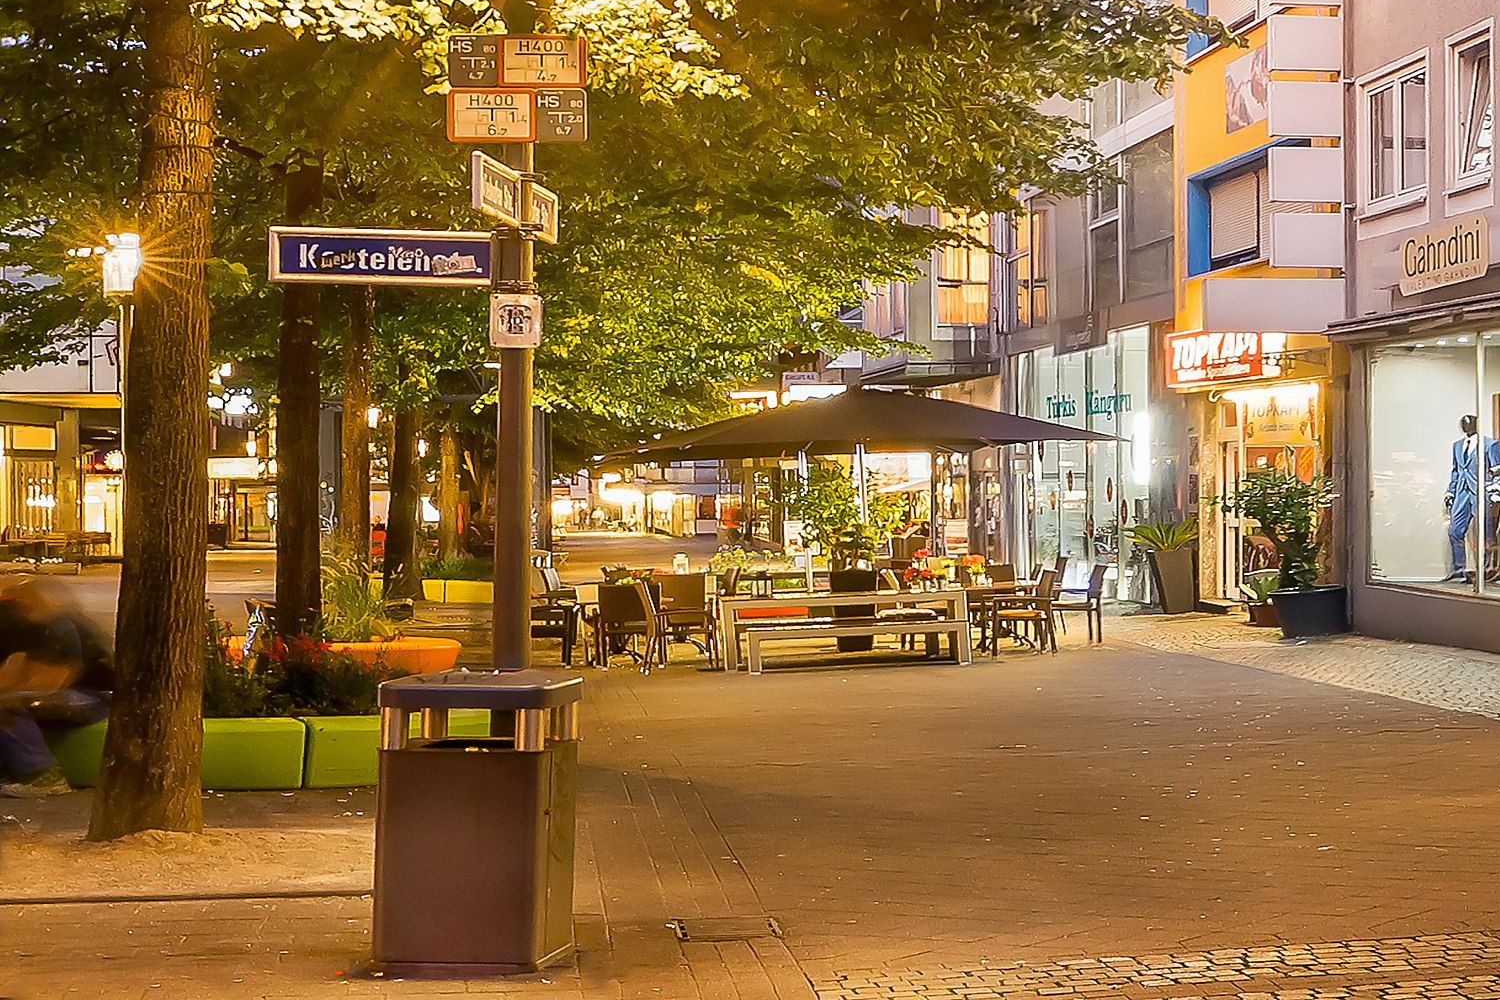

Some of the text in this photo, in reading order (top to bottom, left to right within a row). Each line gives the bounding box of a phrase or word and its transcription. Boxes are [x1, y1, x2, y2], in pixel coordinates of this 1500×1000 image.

[450, 40, 496, 54] HS 80
[519, 40, 564, 52] H400
[469, 95, 514, 107] H400
[537, 95, 583, 108] HS 80
[1405, 219, 1479, 277] Gahndini
[1171, 332, 1259, 370] TOPKAPI
